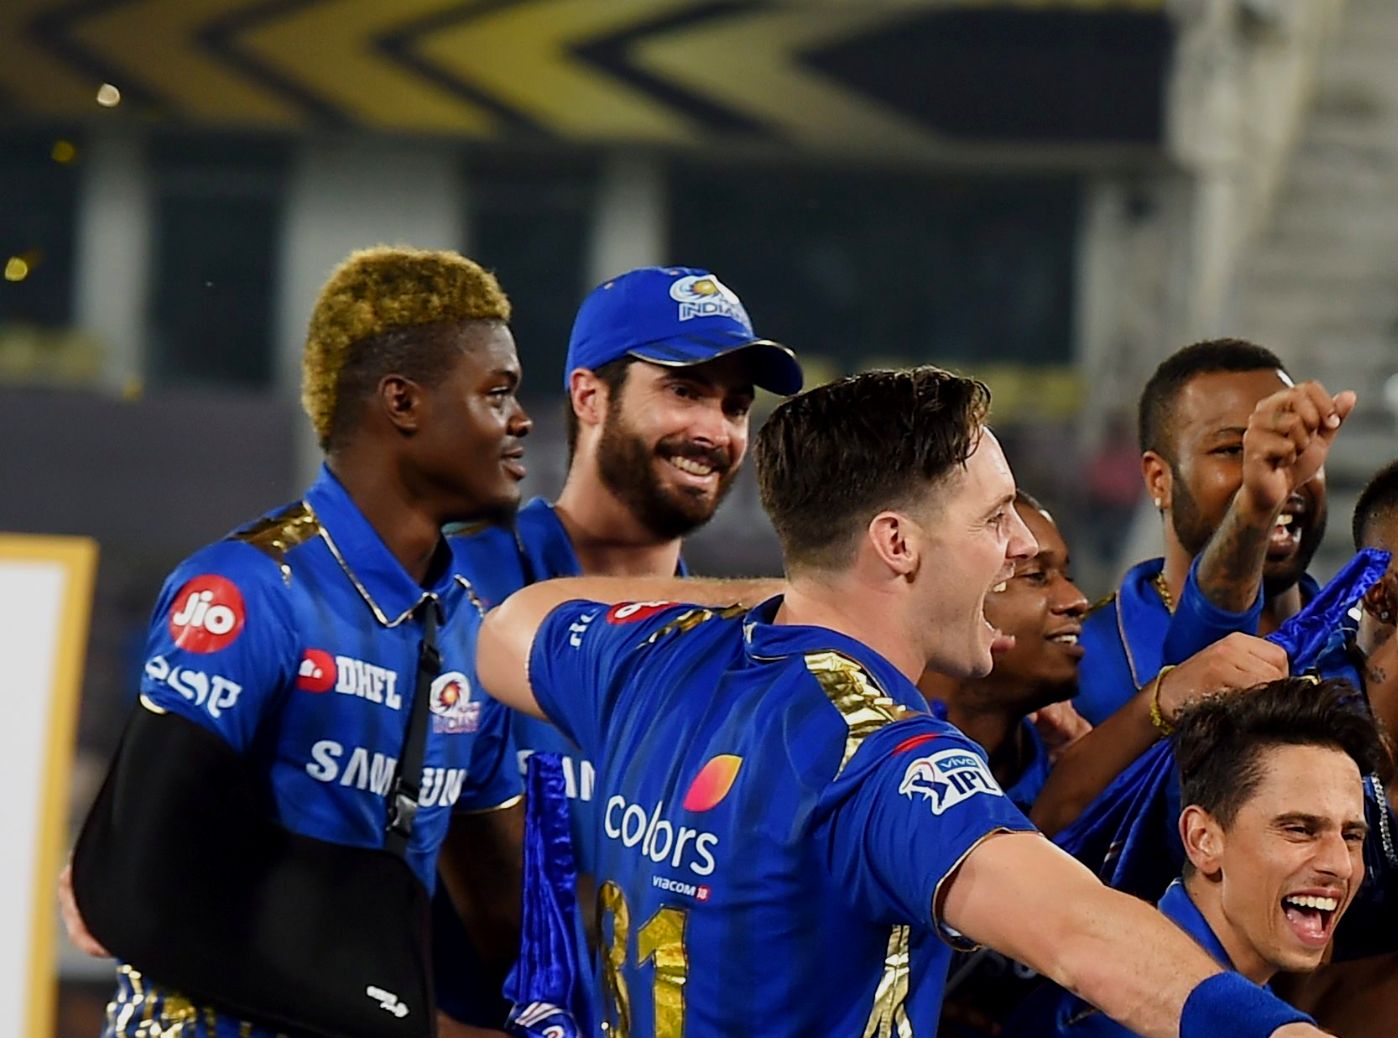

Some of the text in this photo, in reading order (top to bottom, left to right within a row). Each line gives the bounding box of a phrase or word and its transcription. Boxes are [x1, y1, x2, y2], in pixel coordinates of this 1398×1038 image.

[173, 591, 235, 634] Jio
[335, 656, 401, 710] DHFL
[306, 740, 466, 808] SAMUN
[939, 757, 978, 769] vivo
[604, 795, 719, 876] colors
